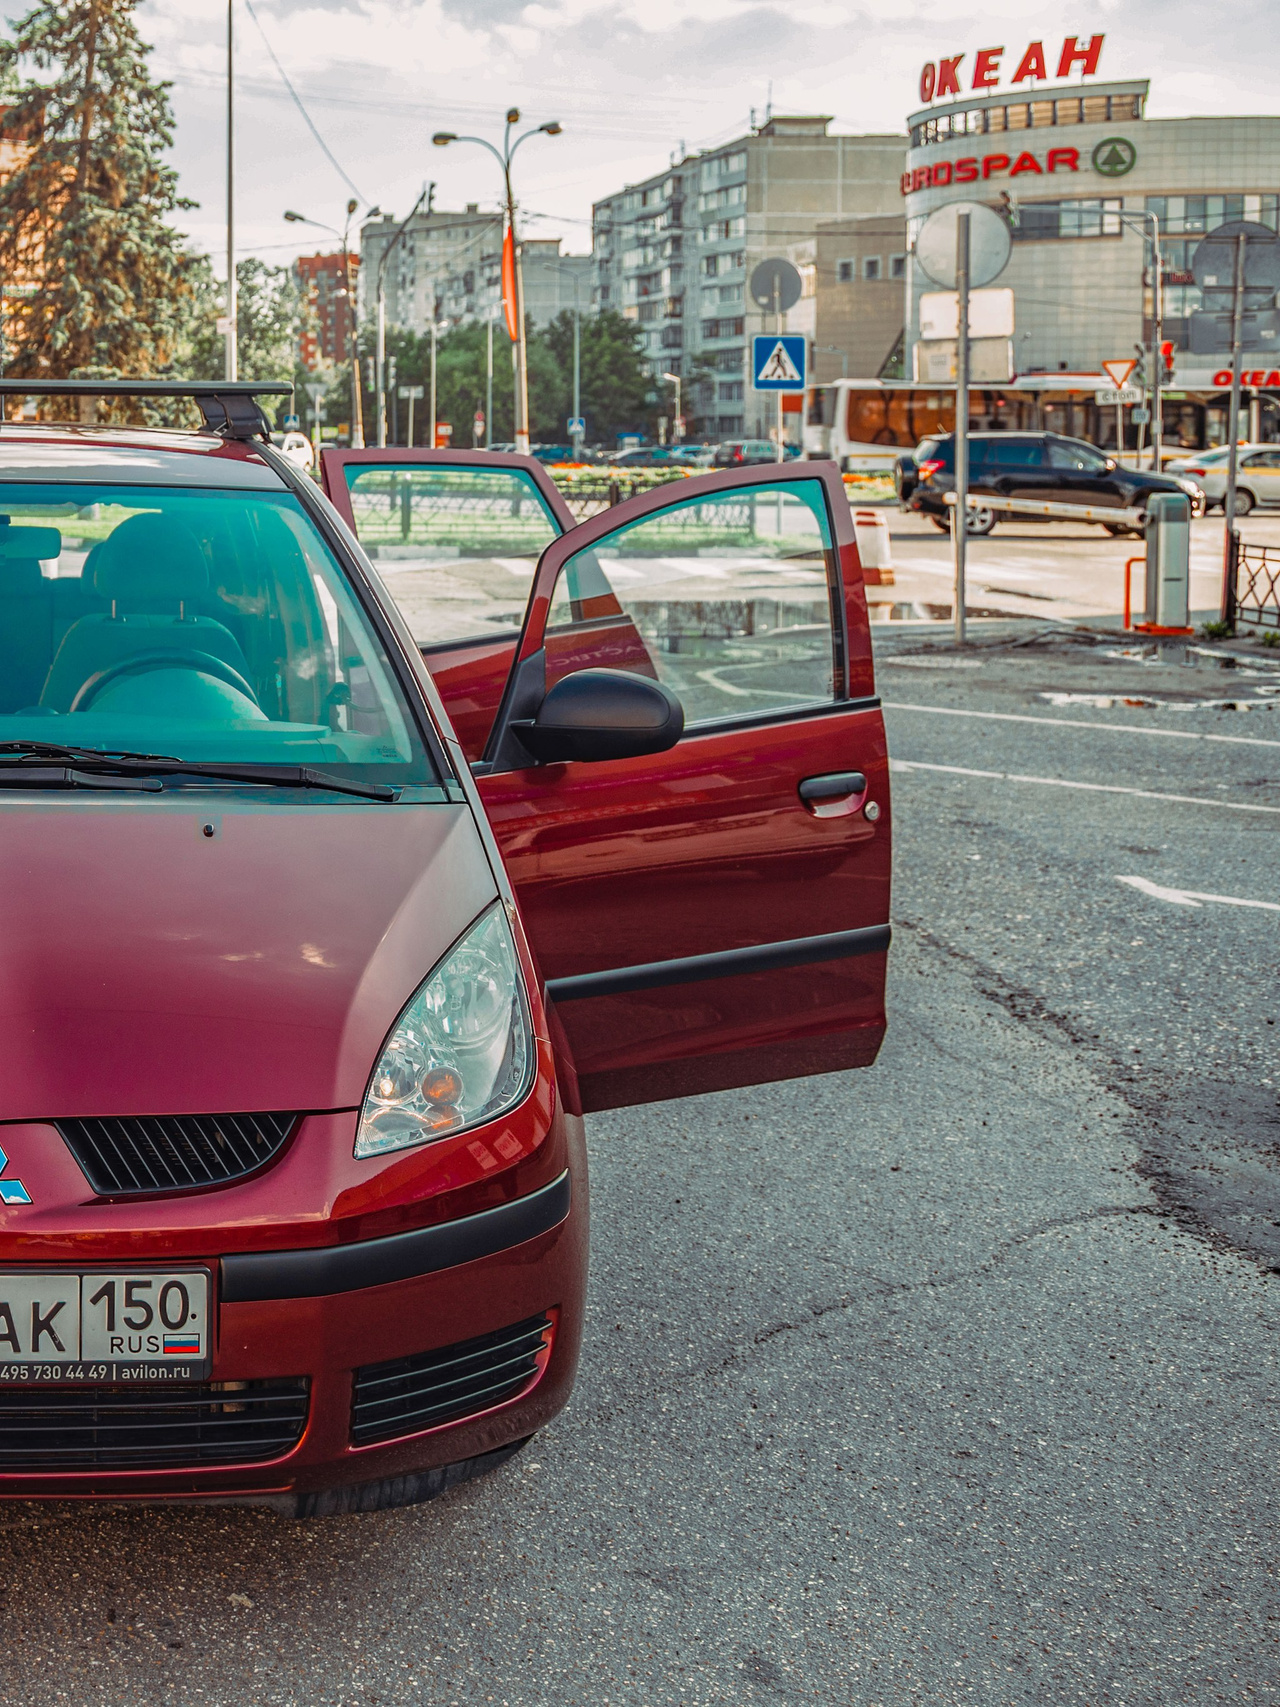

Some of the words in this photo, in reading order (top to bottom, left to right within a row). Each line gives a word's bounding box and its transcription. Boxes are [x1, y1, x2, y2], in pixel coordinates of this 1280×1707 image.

[920, 34, 1106, 103] ОКЕАН
[901, 146, 1080, 196] UROSPAR
[89, 1280, 189, 1331] 150
[110, 1335, 160, 1354] RUS
[0, 1365, 28, 1380] 495
[33, 1365, 61, 1380] 730
[65, 1365, 85, 1380] 44
[88, 1365, 108, 1380] 49
[121, 1364, 190, 1380] avilon.ru
